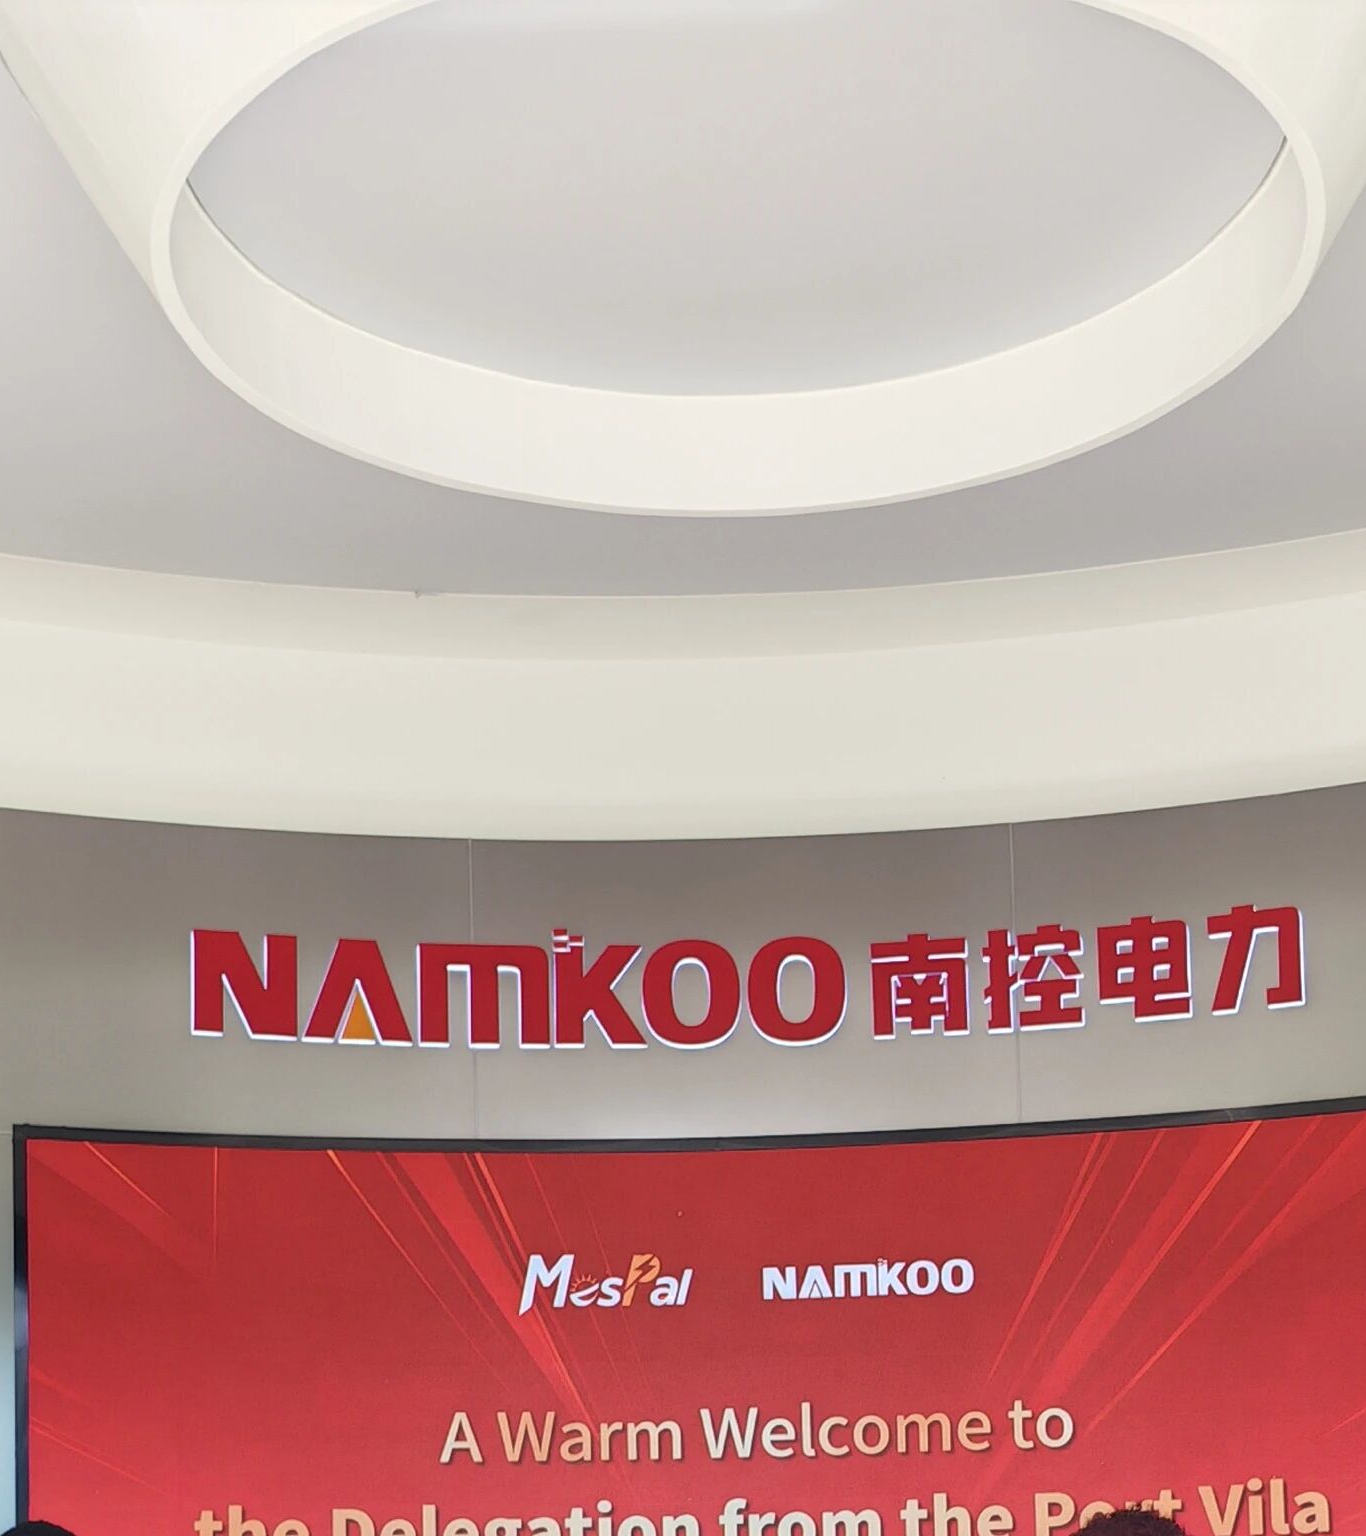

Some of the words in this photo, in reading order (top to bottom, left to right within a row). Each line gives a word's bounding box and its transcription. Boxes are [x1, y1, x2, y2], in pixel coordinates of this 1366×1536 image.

[870, 904, 1307, 1041] 南控电力
[518, 1253, 693, 1316] MesPal
[762, 1257, 974, 1301] NAMKOO
[440, 1411, 483, 1464] A
[497, 1410, 682, 1464] Warm
[699, 1402, 992, 1460] Welcome
[1008, 1399, 1074, 1449] to
